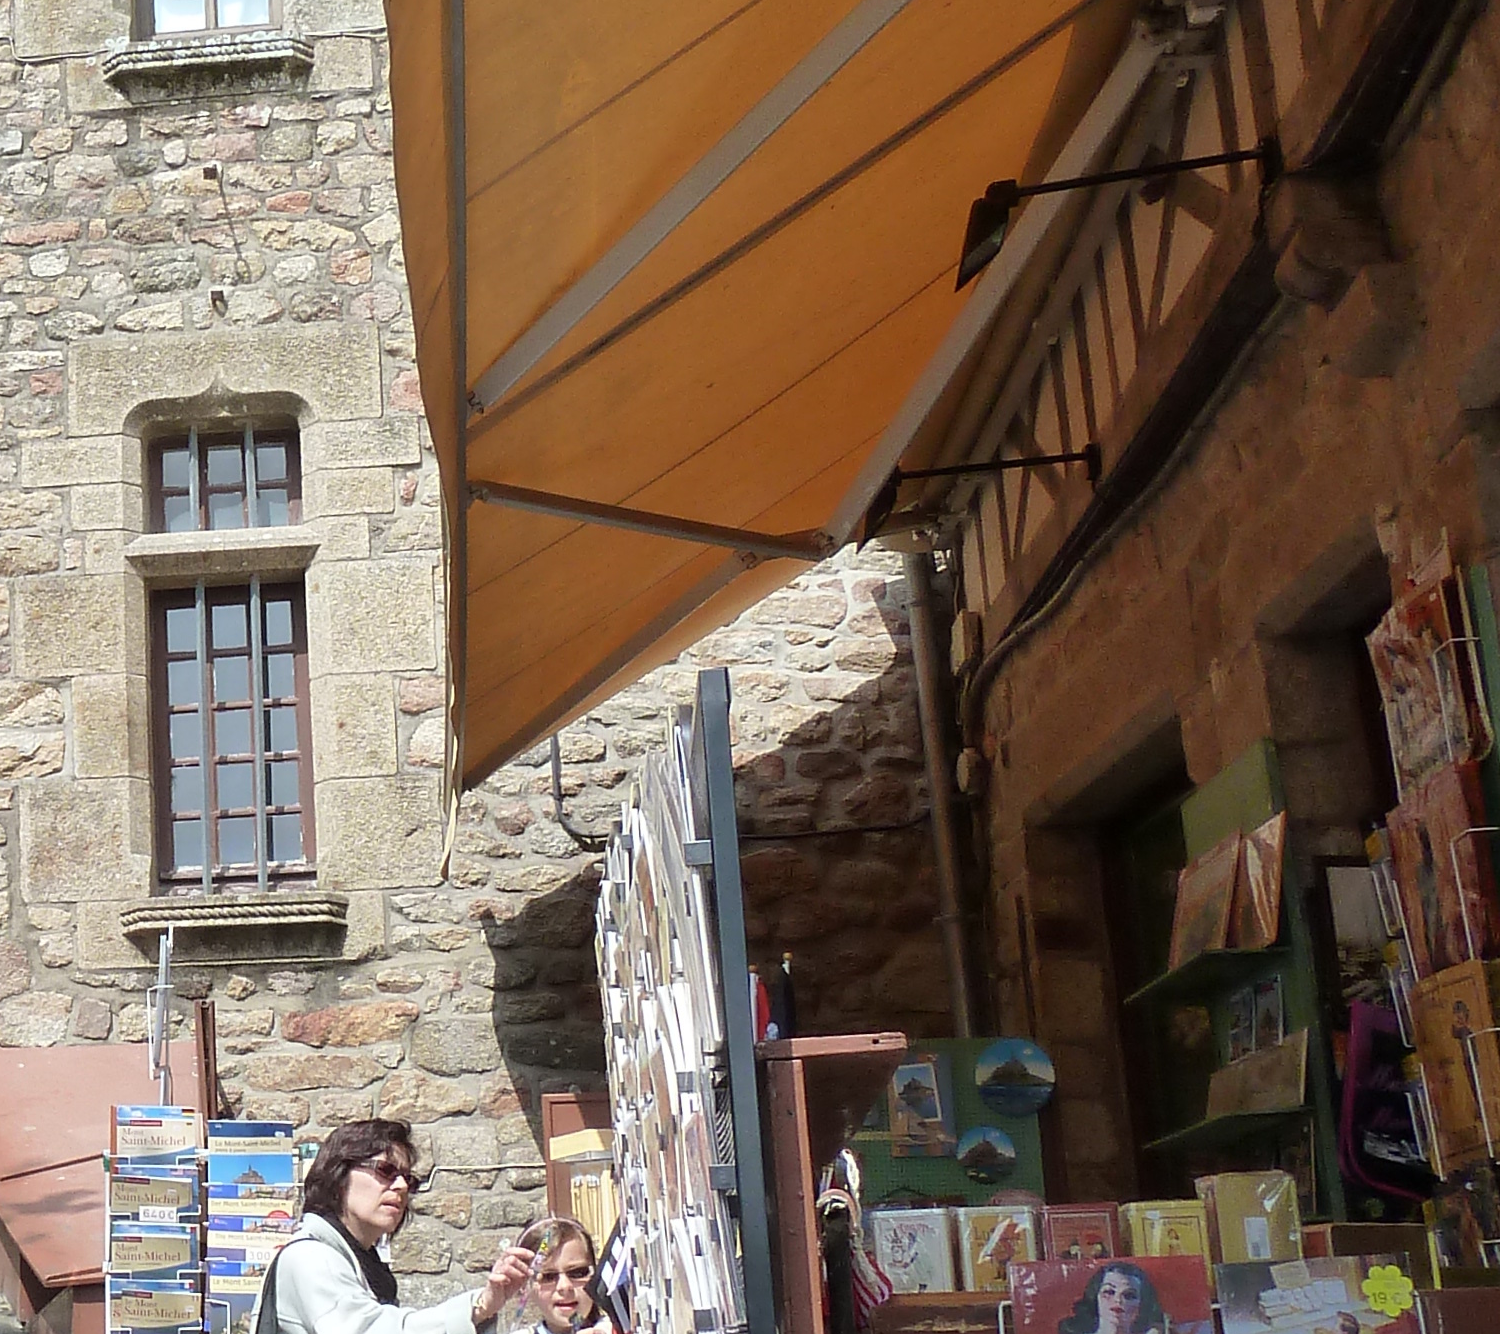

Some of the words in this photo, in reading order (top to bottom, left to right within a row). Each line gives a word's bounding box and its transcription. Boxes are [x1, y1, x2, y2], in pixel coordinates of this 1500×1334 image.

[121, 1135, 186, 1146] Saint-Michel
[114, 1192, 181, 1205] Saint-Michel
[115, 1251, 181, 1261] Saint-Michel
[124, 1306, 192, 1319] Saint-Michel
